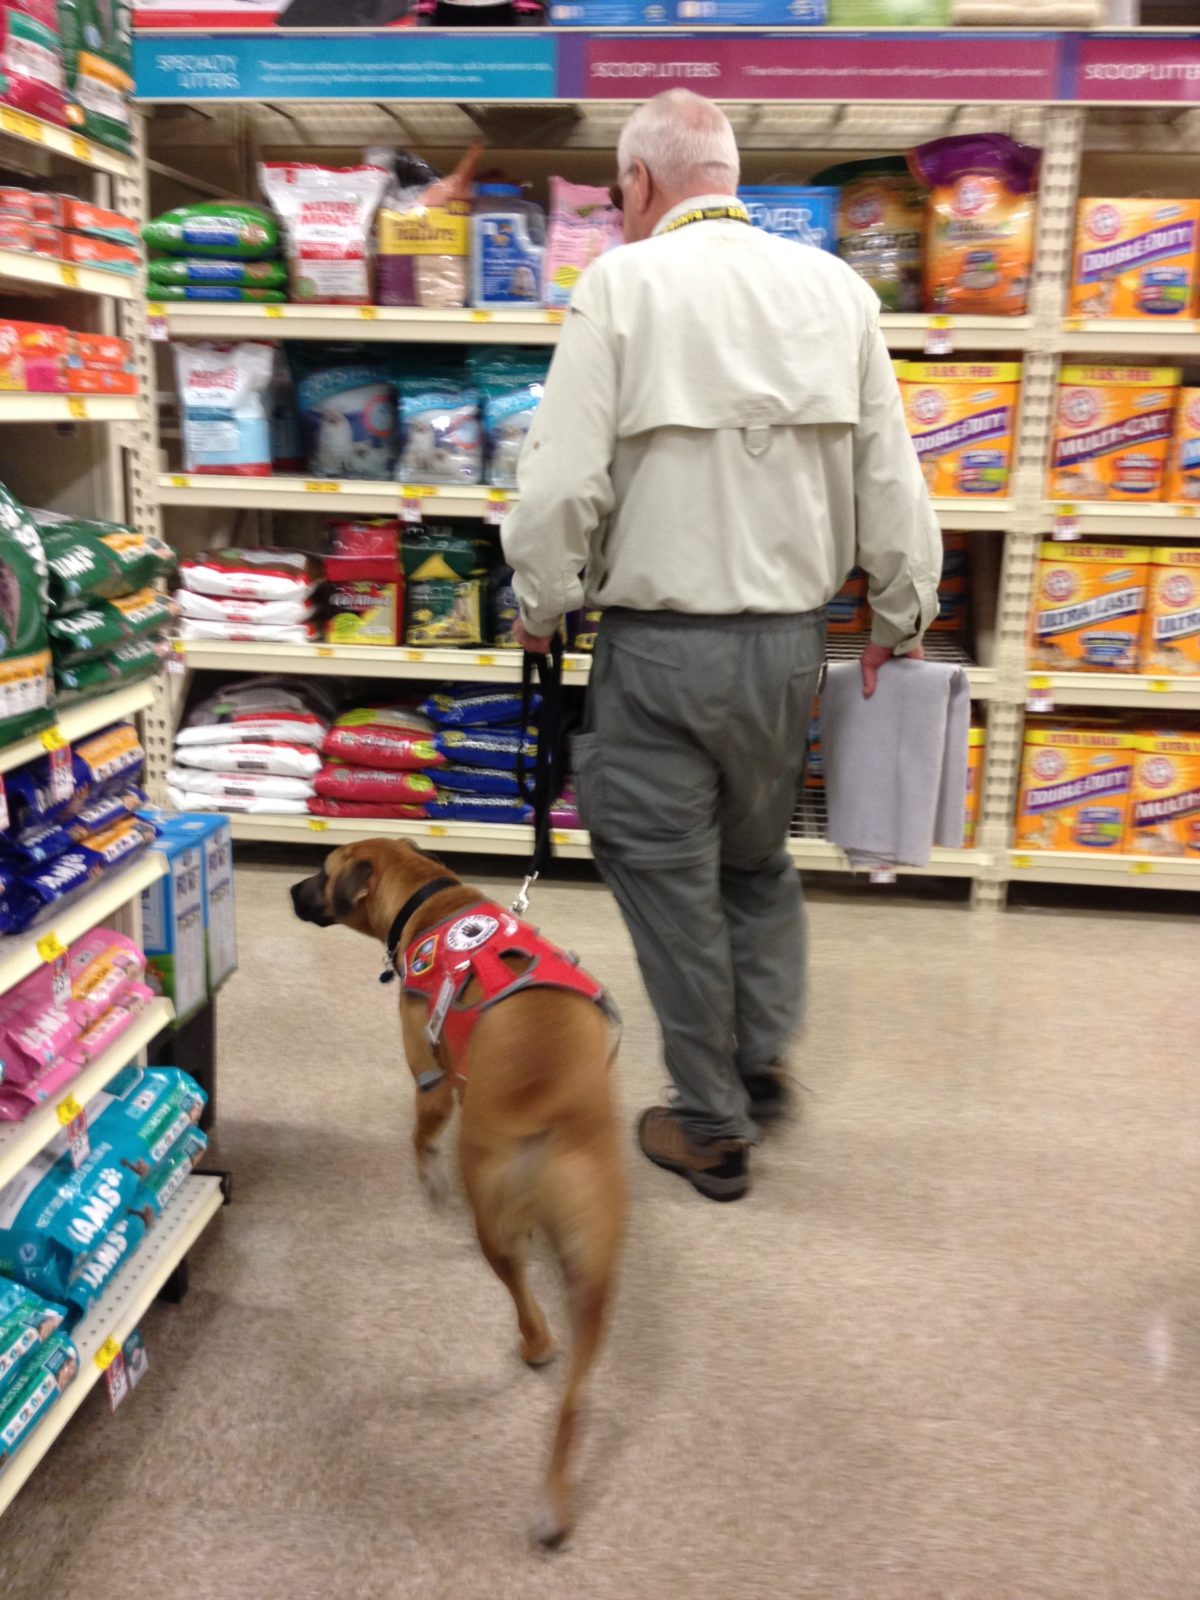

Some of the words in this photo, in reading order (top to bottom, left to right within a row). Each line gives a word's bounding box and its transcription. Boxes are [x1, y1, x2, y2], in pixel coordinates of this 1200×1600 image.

[156, 55, 239, 72] SPECIALTY
[590, 62, 655, 77] SCOOP
[655, 62, 721, 77] LITTERS
[1084, 63, 1150, 79] SCOOP
[178, 72, 241, 89] LITTERS
[67, 1183, 121, 1245] IAMS
[81, 1231, 127, 1289] IAMS
